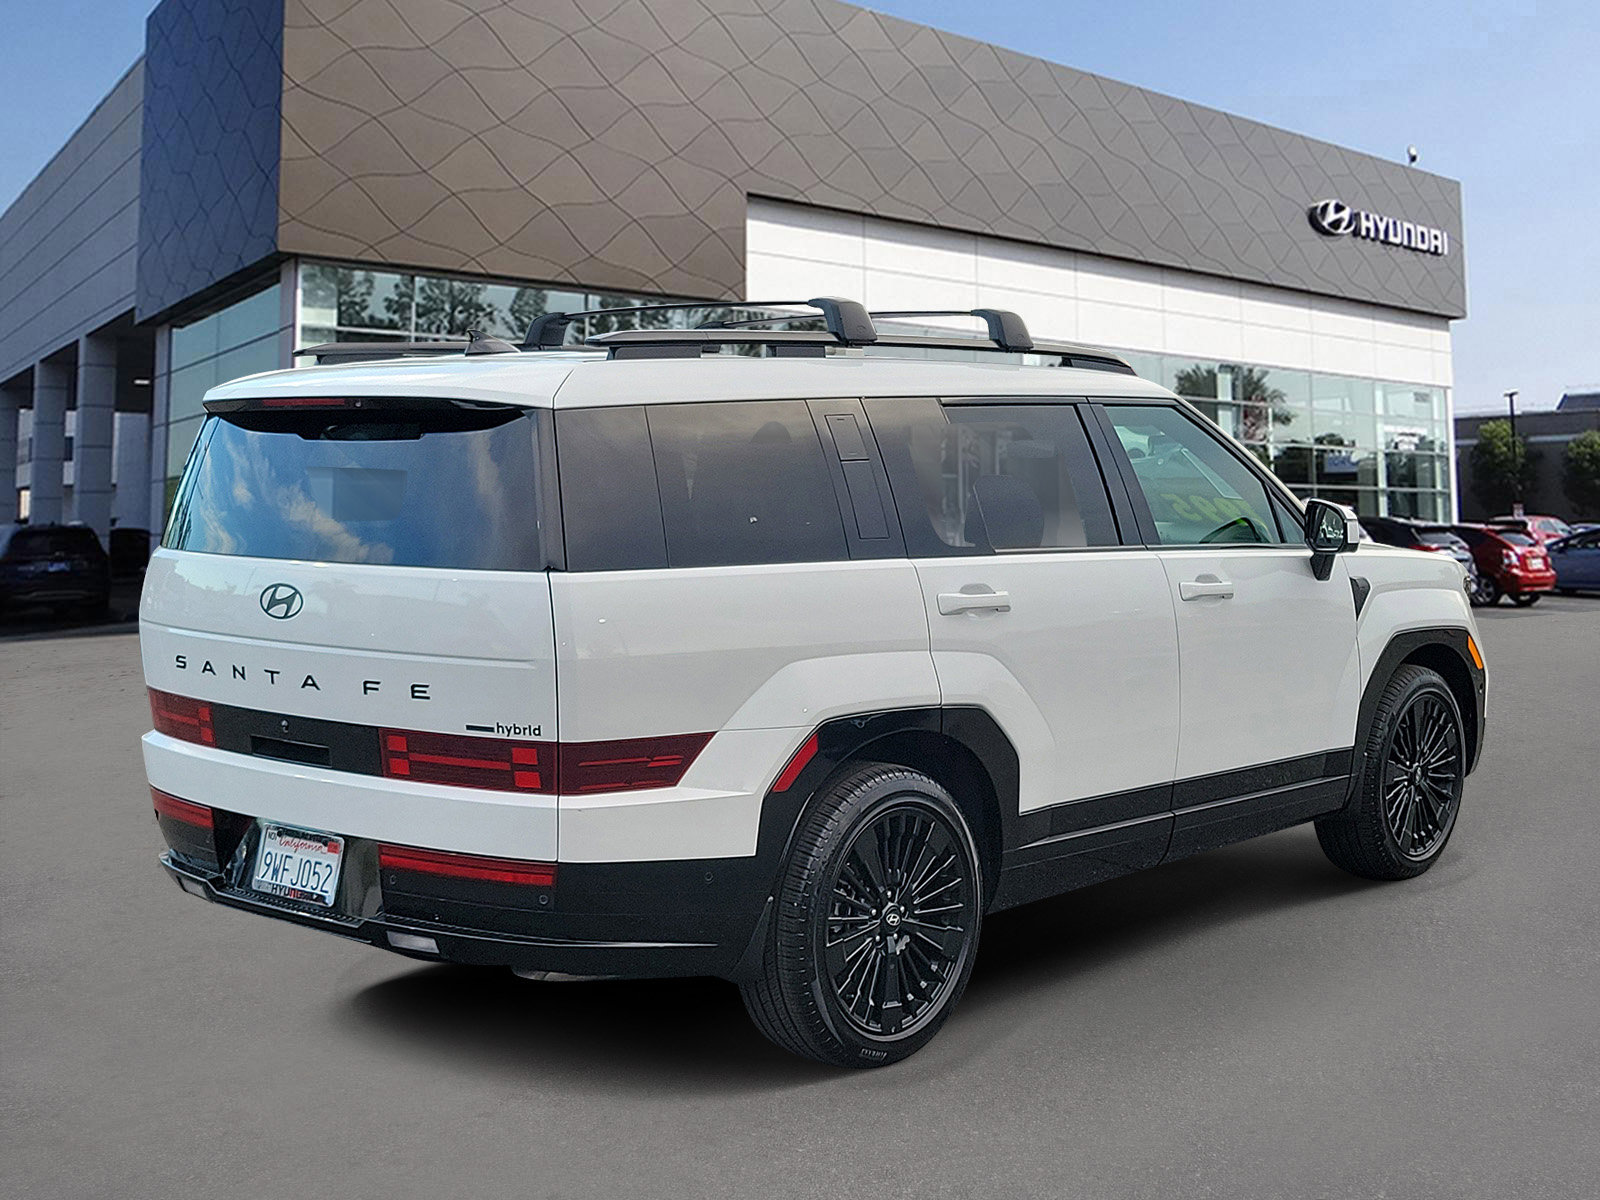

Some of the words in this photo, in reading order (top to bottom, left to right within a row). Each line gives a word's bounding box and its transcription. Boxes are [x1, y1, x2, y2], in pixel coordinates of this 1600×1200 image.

[1360, 210, 1448, 255] HYUNDAI
[175, 654, 321, 691] SANTA
[362, 679, 432, 701] FE
[496, 721, 542, 737] hybrid
[280, 835, 323, 852] California
[261, 851, 332, 893] 9WFJ052
